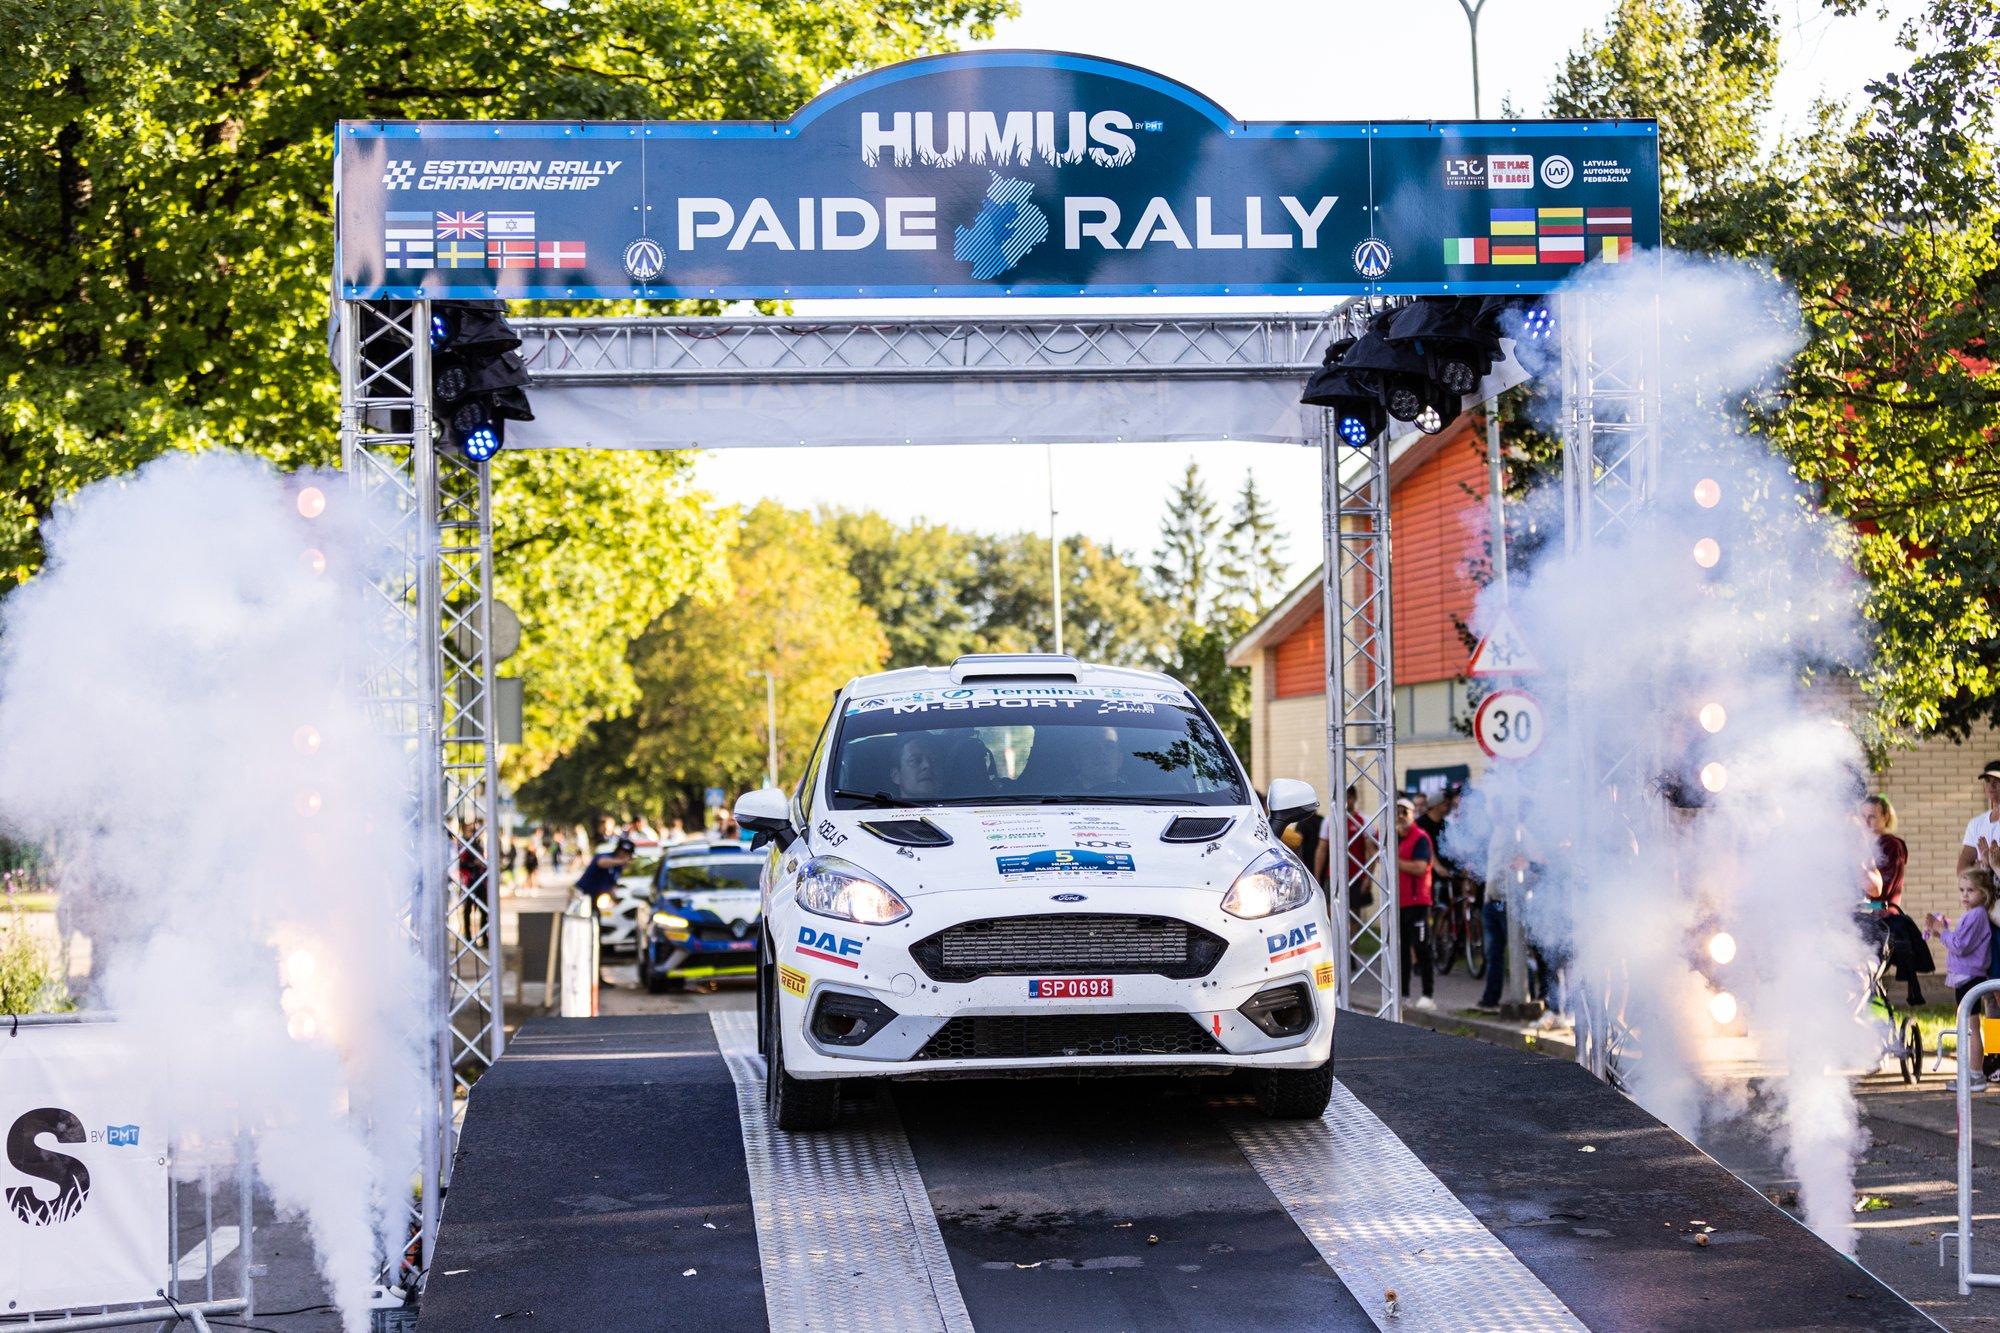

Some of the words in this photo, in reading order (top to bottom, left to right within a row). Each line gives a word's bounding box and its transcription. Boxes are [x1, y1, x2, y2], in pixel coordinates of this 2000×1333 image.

[1135, 122, 1144, 130] BY
[861, 110, 1136, 168] HUMUS
[423, 160, 542, 175] ESTONIAN
[547, 160, 622, 175] RALLY
[1492, 161, 1507, 170] THE
[1507, 161, 1530, 170] PLACE
[1548, 167, 1566, 176] LAF
[417, 175, 600, 190] CHAMPIONSHIP
[1493, 174, 1503, 183] TO
[678, 196, 937, 251] PAIDE
[1064, 195, 1339, 250] RALLY
[988, 687, 1095, 697] Terminal
[893, 699, 1082, 715] M-SPORT
[1493, 710, 1531, 743] 30
[1075, 840, 1132, 849] NONS
[1055, 850, 1074, 863] 5
[797, 926, 864, 956] DAF
[1266, 922, 1318, 954] DAF
[1041, 980, 1065, 997] SP
[1068, 980, 1109, 996] 0698
[90, 1130, 106, 1143] BY
[109, 1129, 138, 1142] PMT
[6, 1107, 90, 1226] S
